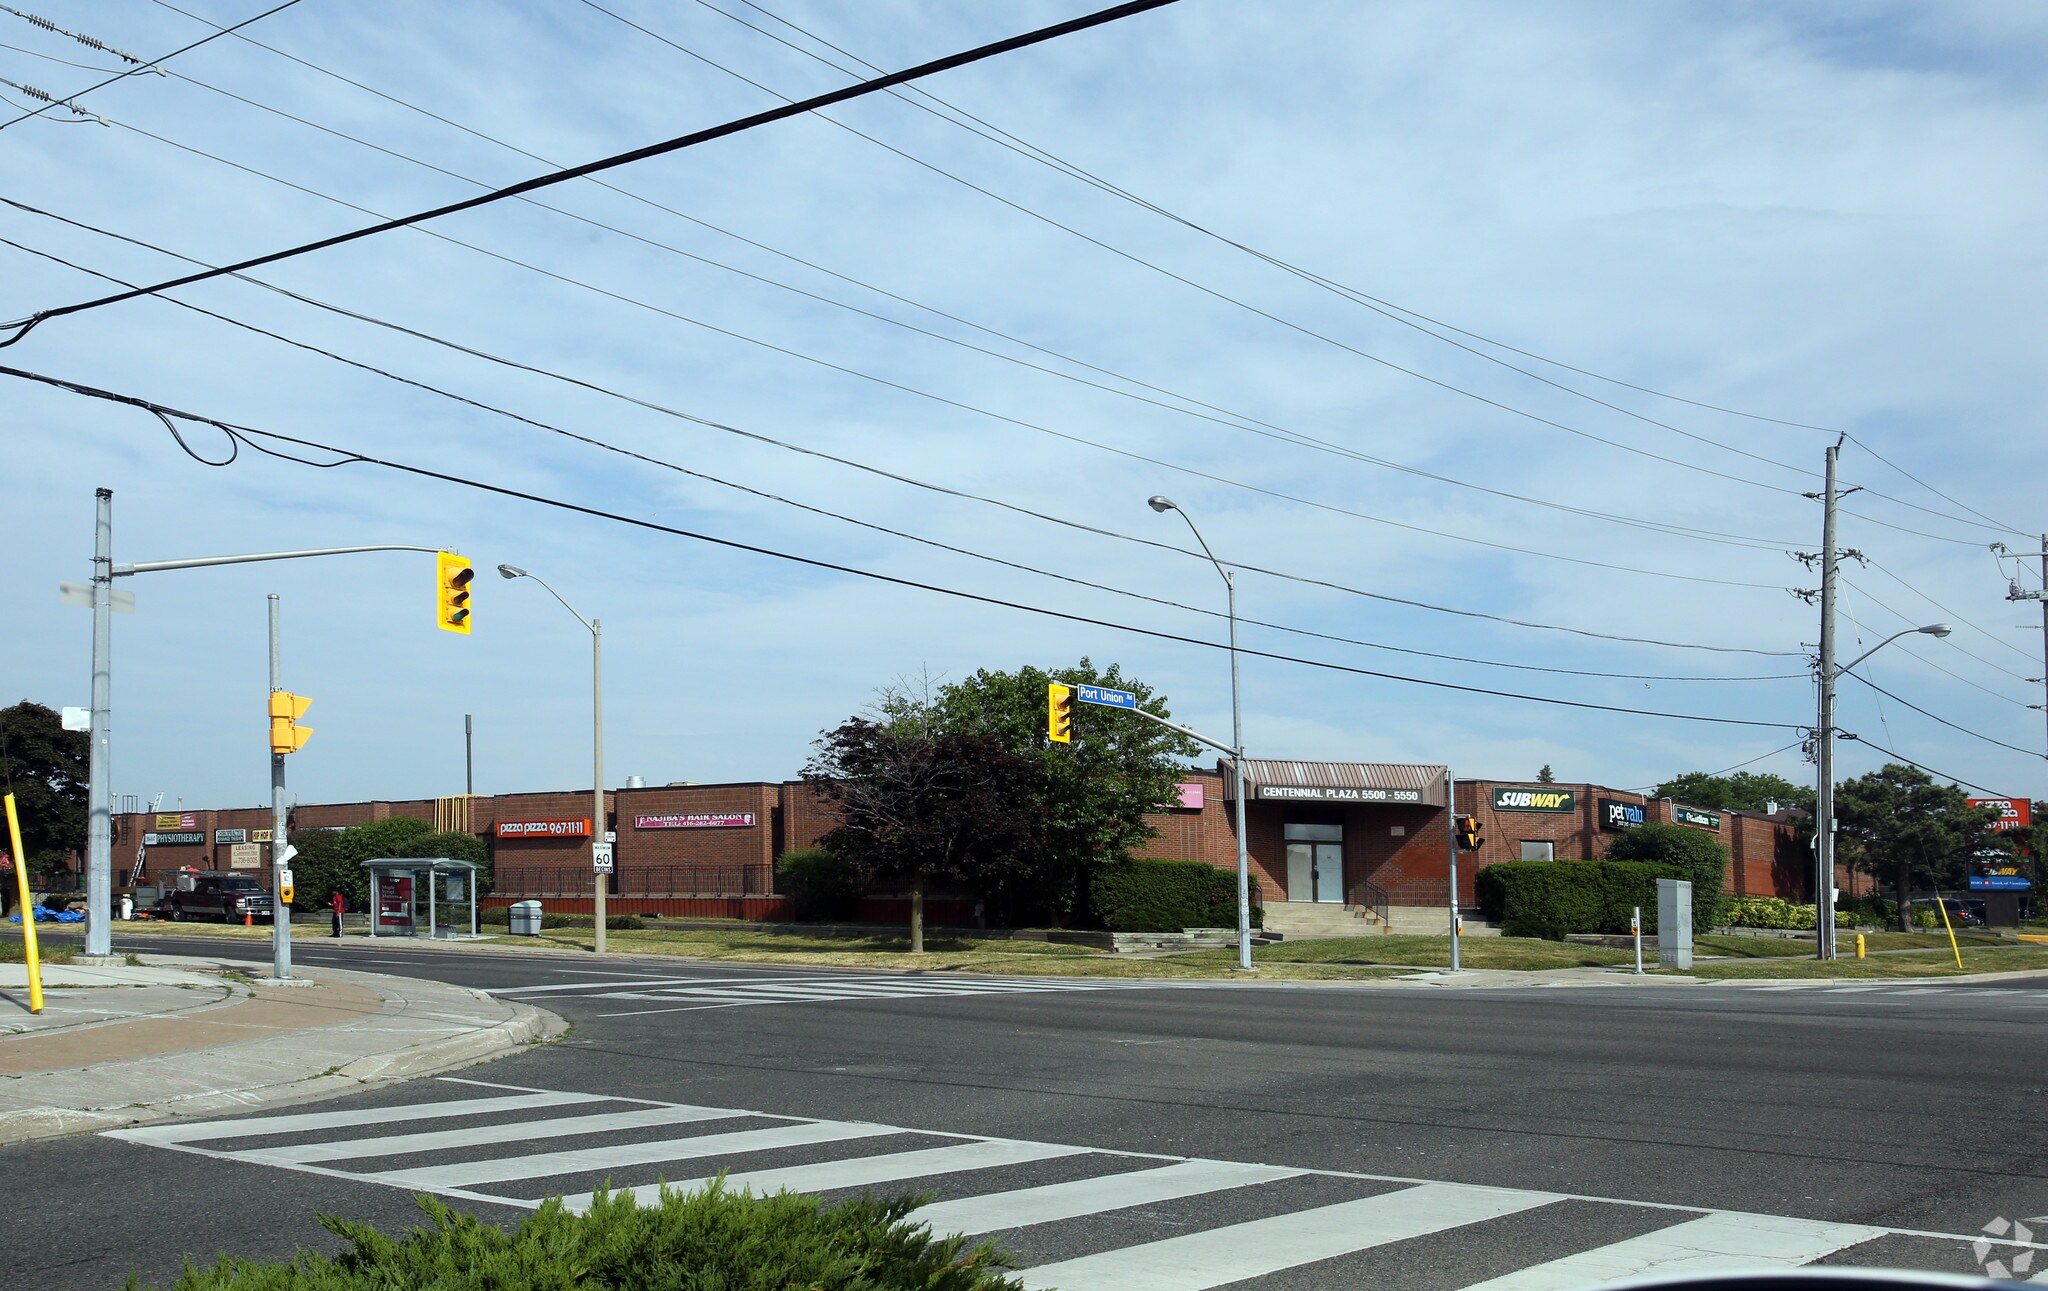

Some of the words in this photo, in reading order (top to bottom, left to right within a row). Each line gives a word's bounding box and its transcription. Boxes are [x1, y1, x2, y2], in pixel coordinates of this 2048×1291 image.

[1080, 686, 1098, 700] Port
[1100, 690, 1124, 704] Union
[1263, 787, 1323, 798] CENTENNIAL
[1326, 790, 1358, 799] PLAZA
[1361, 790, 1385, 800] 5500
[1394, 791, 1418, 801] 5550
[1496, 792, 1570, 808] SUBWAY
[1608, 803, 1625, 823] pet
[1624, 805, 1643, 823] valu
[500, 823, 523, 835] pizza
[523, 822, 548, 835] pizza
[157, 833, 204, 843] PHYSIOTHERAPY
[596, 853, 610, 865] 60
